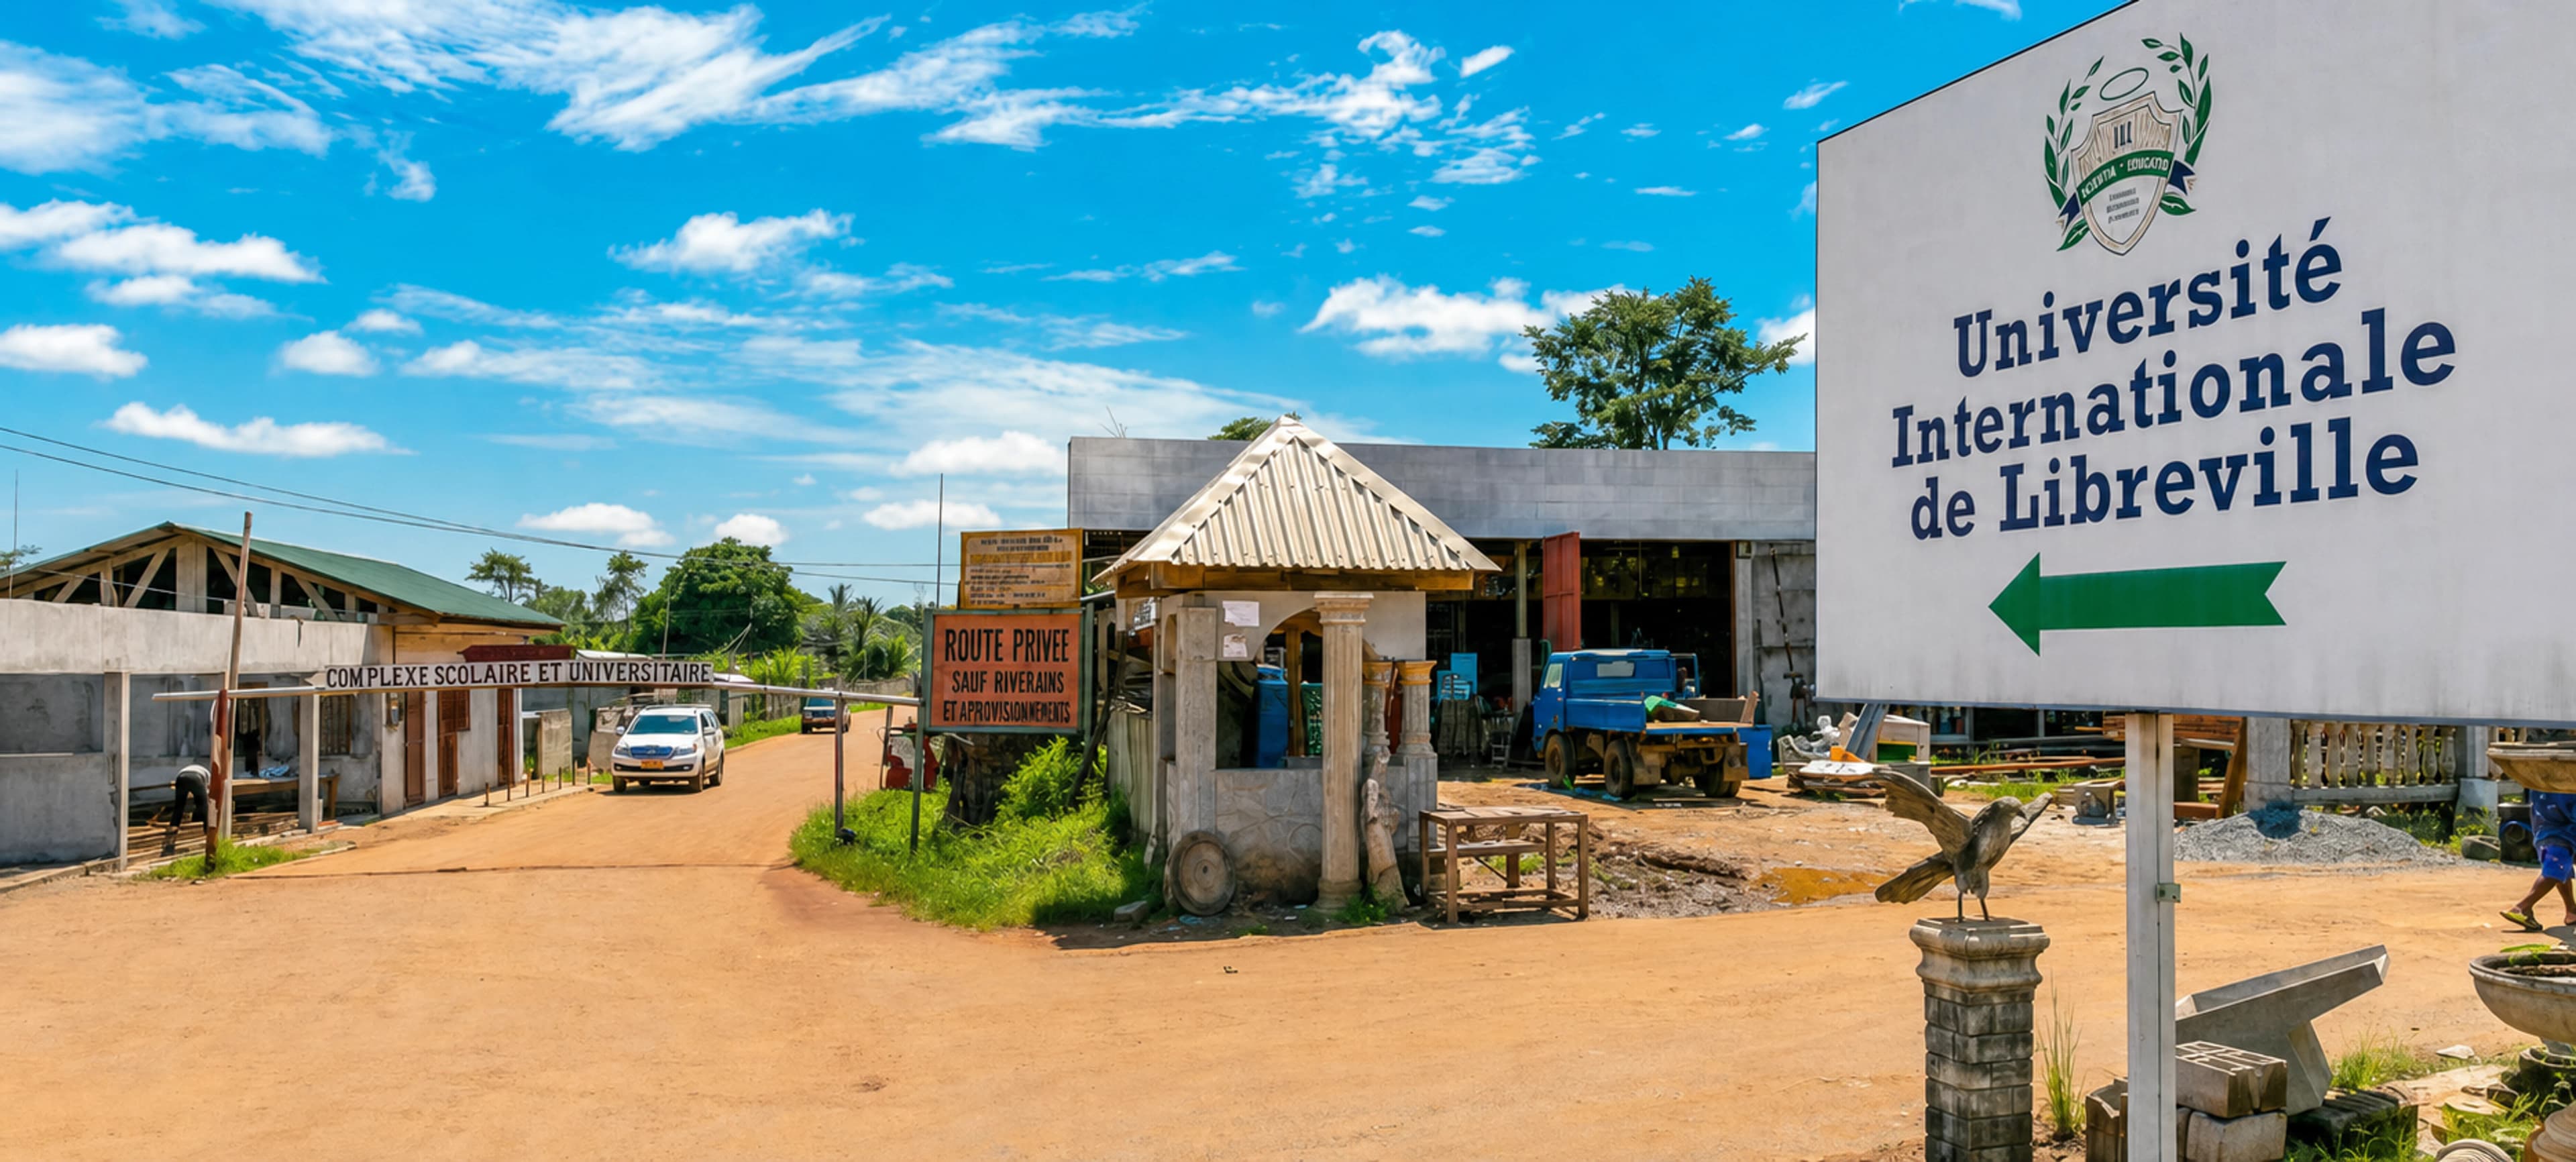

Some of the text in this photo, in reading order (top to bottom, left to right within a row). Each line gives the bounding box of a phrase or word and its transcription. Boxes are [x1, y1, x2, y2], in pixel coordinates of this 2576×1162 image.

[1953, 216, 2344, 378] Université
[1891, 307, 2457, 468] Internationale
[1911, 415, 2420, 541] de Libreville
[945, 628, 1069, 663] ROUTE PRIVEE
[326, 662, 712, 688] COMPLEXE SCOLAIRE ET UNIVERSITAIRE
[951, 670, 1065, 694] SAUF RIVERAINS
[943, 700, 958, 722] ET
